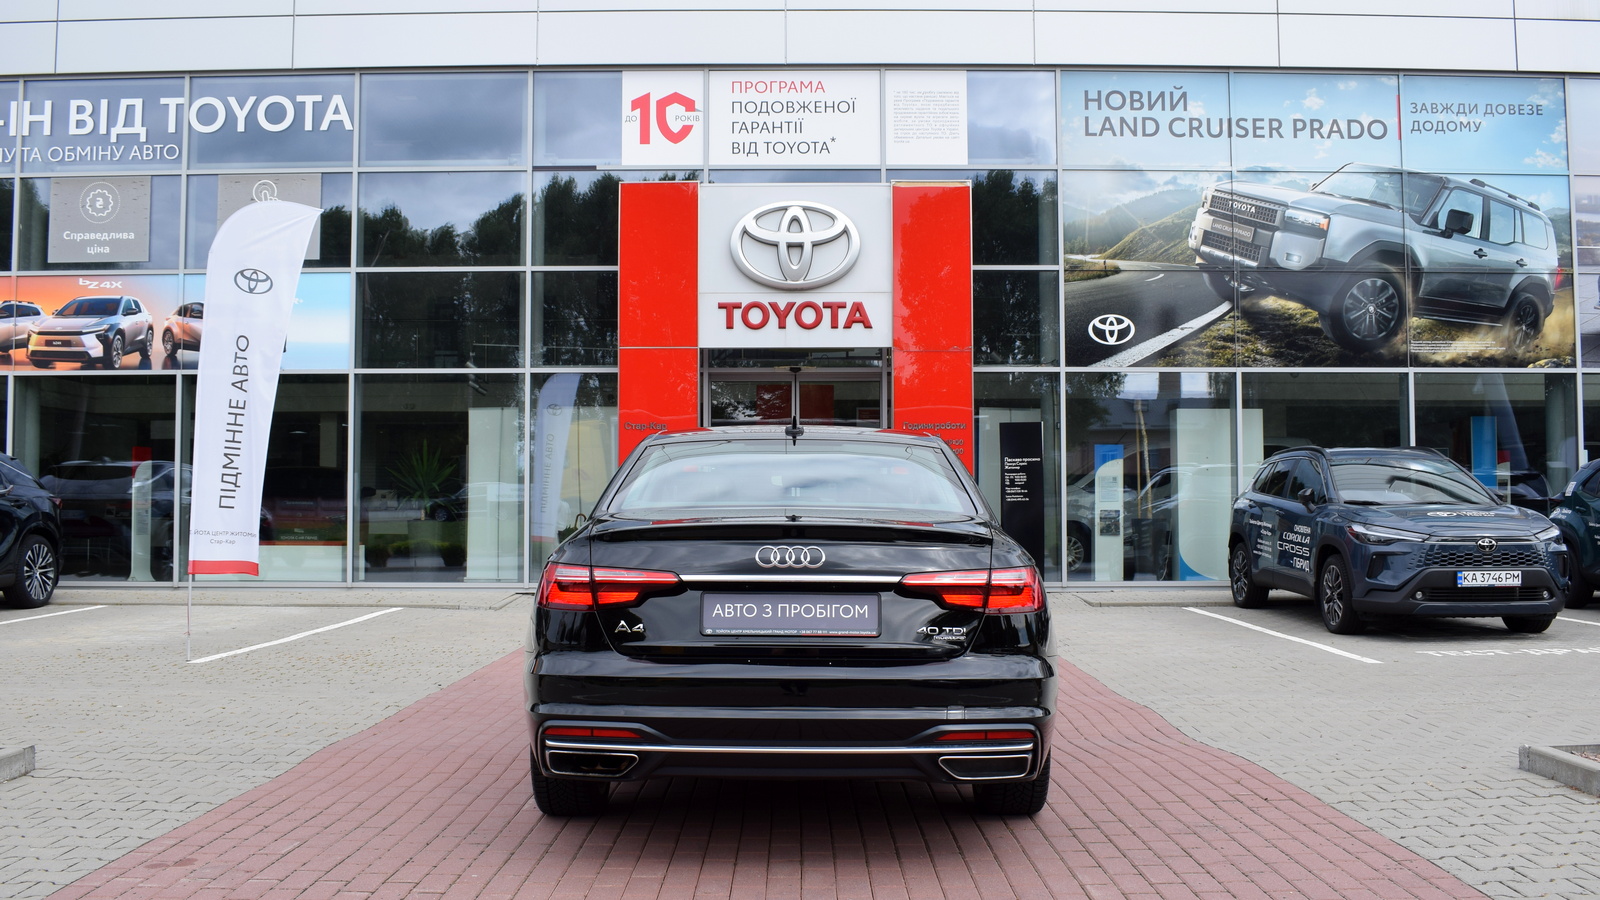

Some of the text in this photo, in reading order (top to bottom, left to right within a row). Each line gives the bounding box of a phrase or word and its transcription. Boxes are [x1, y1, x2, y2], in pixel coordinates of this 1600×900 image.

[731, 81, 826, 94] ПРОГРАМА
[1084, 85, 1188, 112] НОВИЙ
[731, 97, 856, 117] ПОДОВЖЕНОЇ
[1410, 102, 1544, 118] ЗАВЖДИ ДОВЕЗЕ
[68, 98, 147, 143] ВІД
[160, 95, 353, 133] TOYOTA
[625, 115, 638, 123] ДО
[731, 118, 803, 134] ГАРАНТІЇ
[1084, 116, 1388, 140] LAND CRUISER PRADO
[1410, 120, 1482, 134] ДОДОМУ
[0, 144, 180, 163] У ТА ОБМІНУ АВТО
[731, 141, 759, 157] ВІД
[1228, 201, 1256, 213] TOYOTA
[63, 230, 135, 242] Справедлива
[87, 244, 110, 255] ціна
[718, 301, 873, 330] TOYOTA
[218, 335, 250, 509] ПІДМІННЕ АВТО
[624, 422, 668, 431] Стар-Кар
[903, 422, 966, 431] Години роботи
[1283, 531, 1310, 544] COROLLA
[1277, 541, 1310, 557] CROSS
[1463, 573, 1520, 583] KA 3746 PM
[712, 603, 869, 619] АВТО З ПРОБІГОМ
[614, 620, 644, 633] A4
[916, 626, 939, 635] 40
